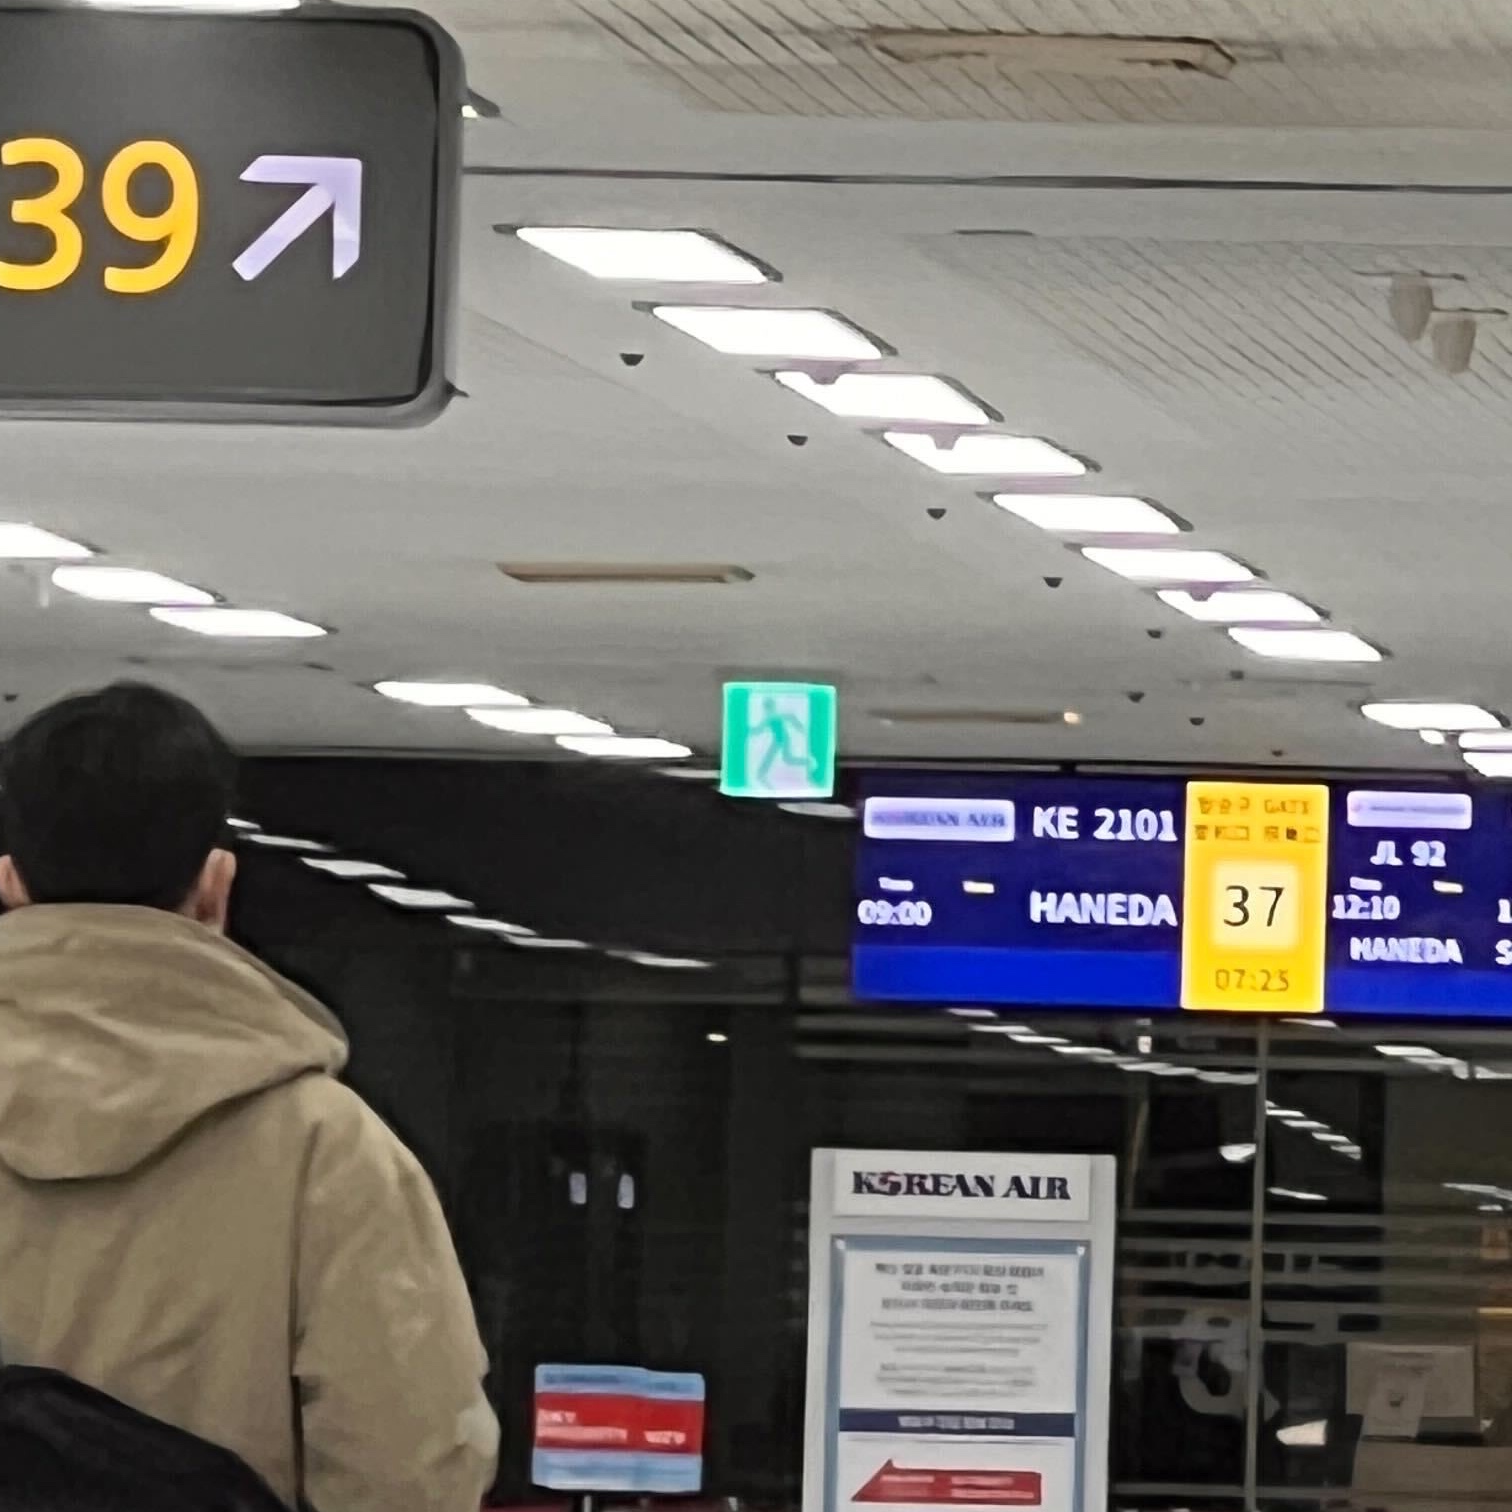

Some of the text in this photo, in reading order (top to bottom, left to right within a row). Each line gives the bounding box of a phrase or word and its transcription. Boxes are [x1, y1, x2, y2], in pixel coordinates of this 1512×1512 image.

[1033, 806, 1080, 839] KE
[1092, 807, 1179, 842] 2101
[1029, 889, 1179, 927] HANEDA
[1223, 884, 1285, 928] 37
[851, 1170, 1072, 1200] KOREAN AIR
